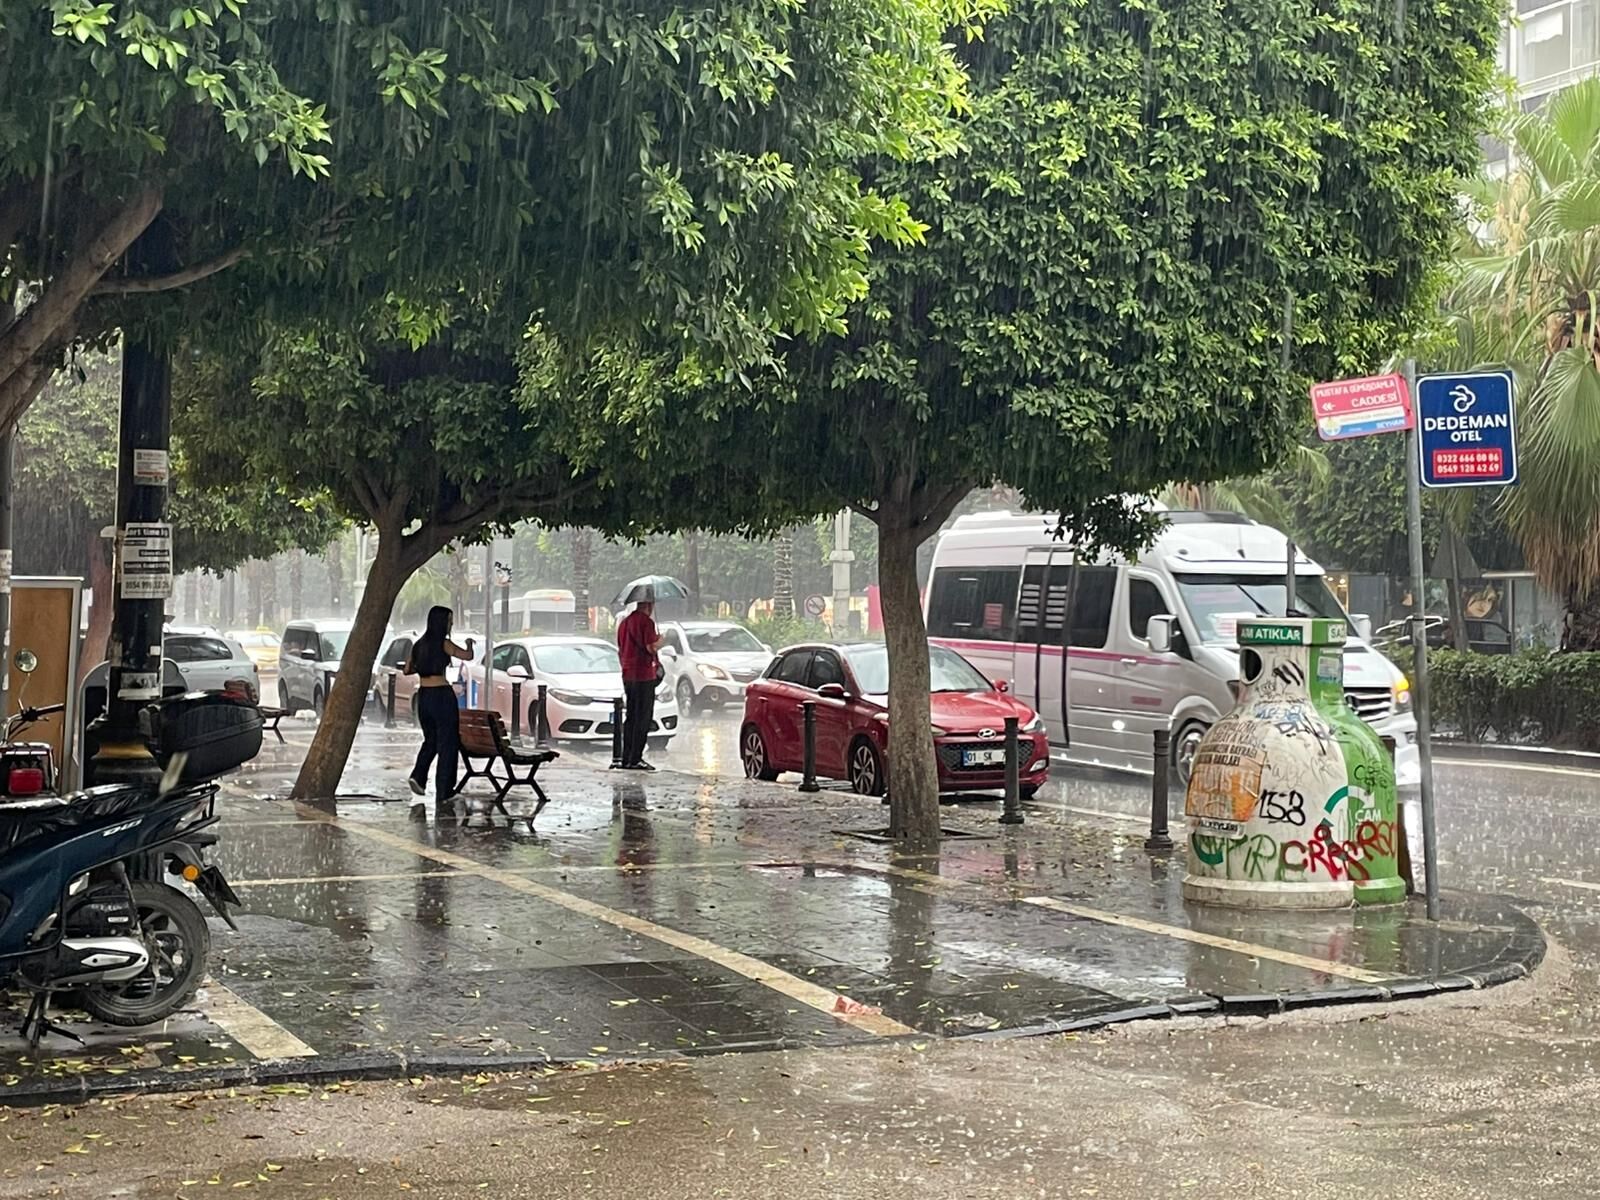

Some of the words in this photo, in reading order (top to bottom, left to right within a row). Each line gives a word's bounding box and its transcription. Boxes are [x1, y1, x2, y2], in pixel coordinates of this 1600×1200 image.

[1424, 414, 1507, 431] DEDEMAN
[1450, 430, 1482, 442] OTEL
[1255, 628, 1301, 641] ATIKLAR
[967, 753, 976, 761] 01
